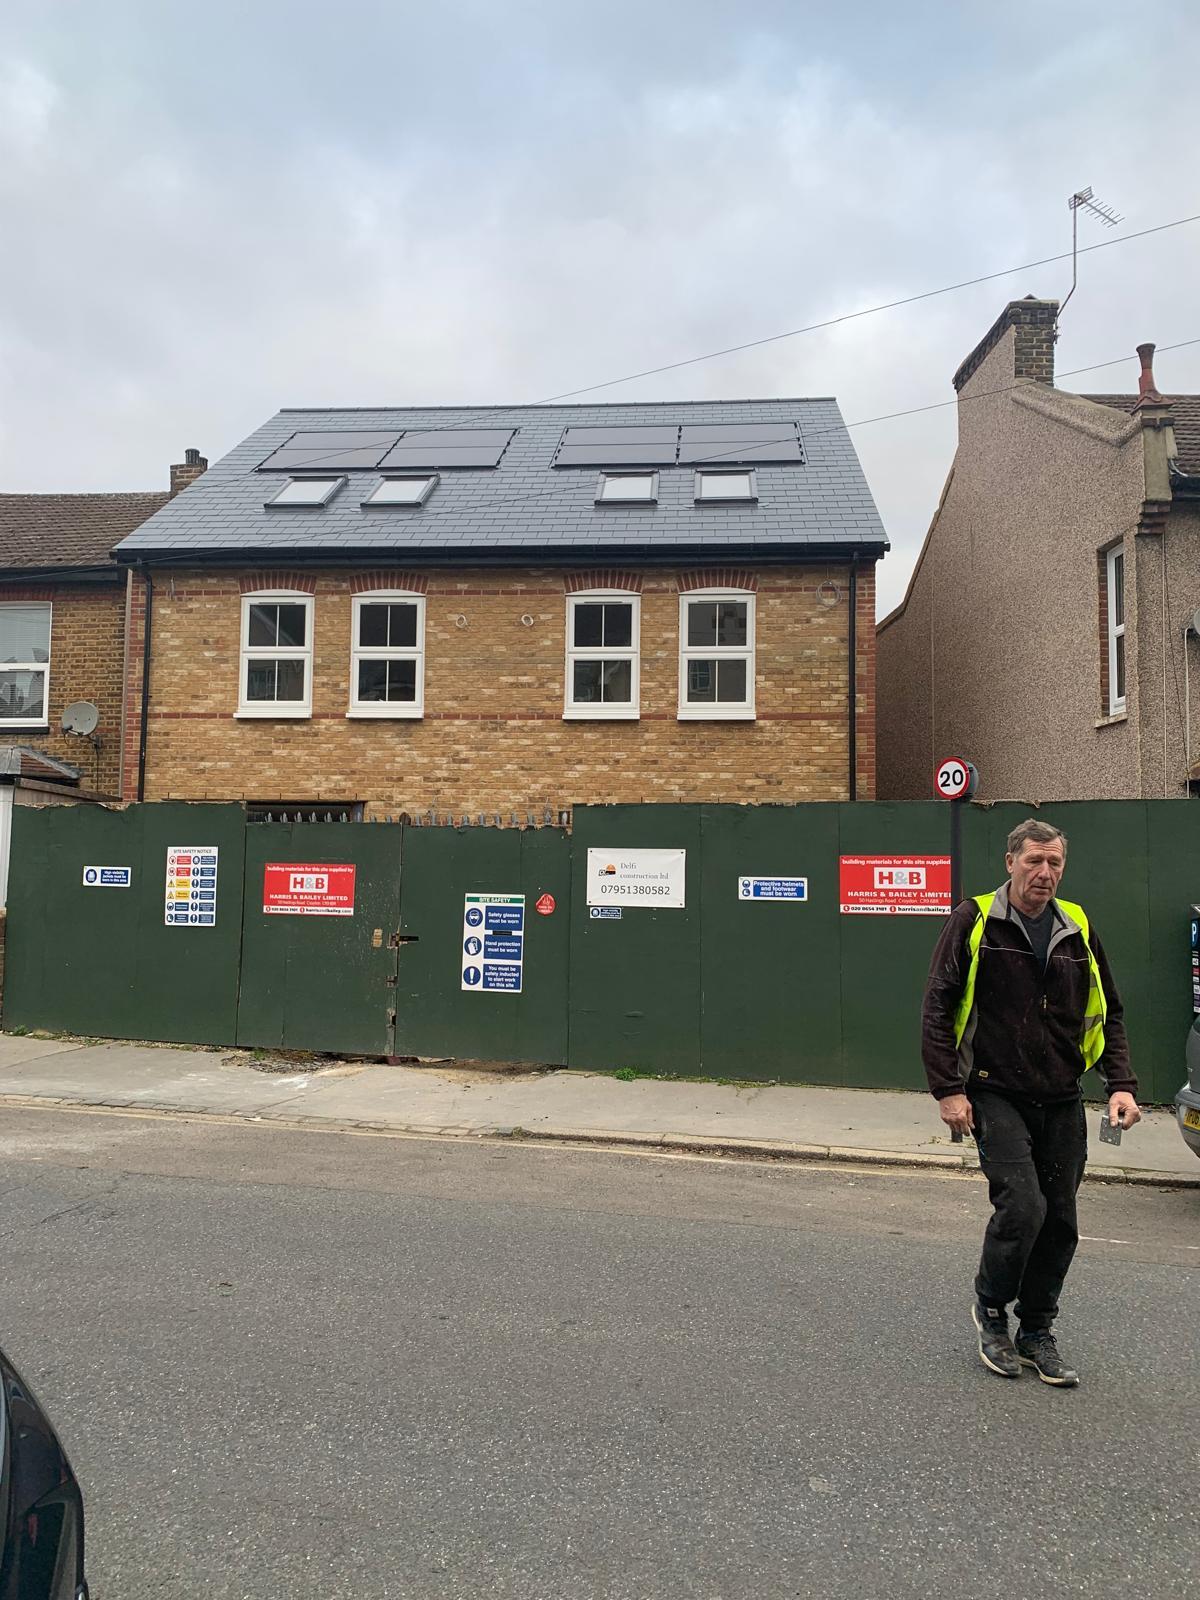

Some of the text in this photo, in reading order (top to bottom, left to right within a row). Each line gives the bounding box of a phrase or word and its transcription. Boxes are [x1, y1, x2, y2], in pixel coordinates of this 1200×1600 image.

[940, 769, 964, 787] 20
[292, 877, 325, 889] H&B
[879, 872, 921, 885] H&B
[601, 885, 670, 895] 07951380582
[1191, 923, 1197, 942] P
